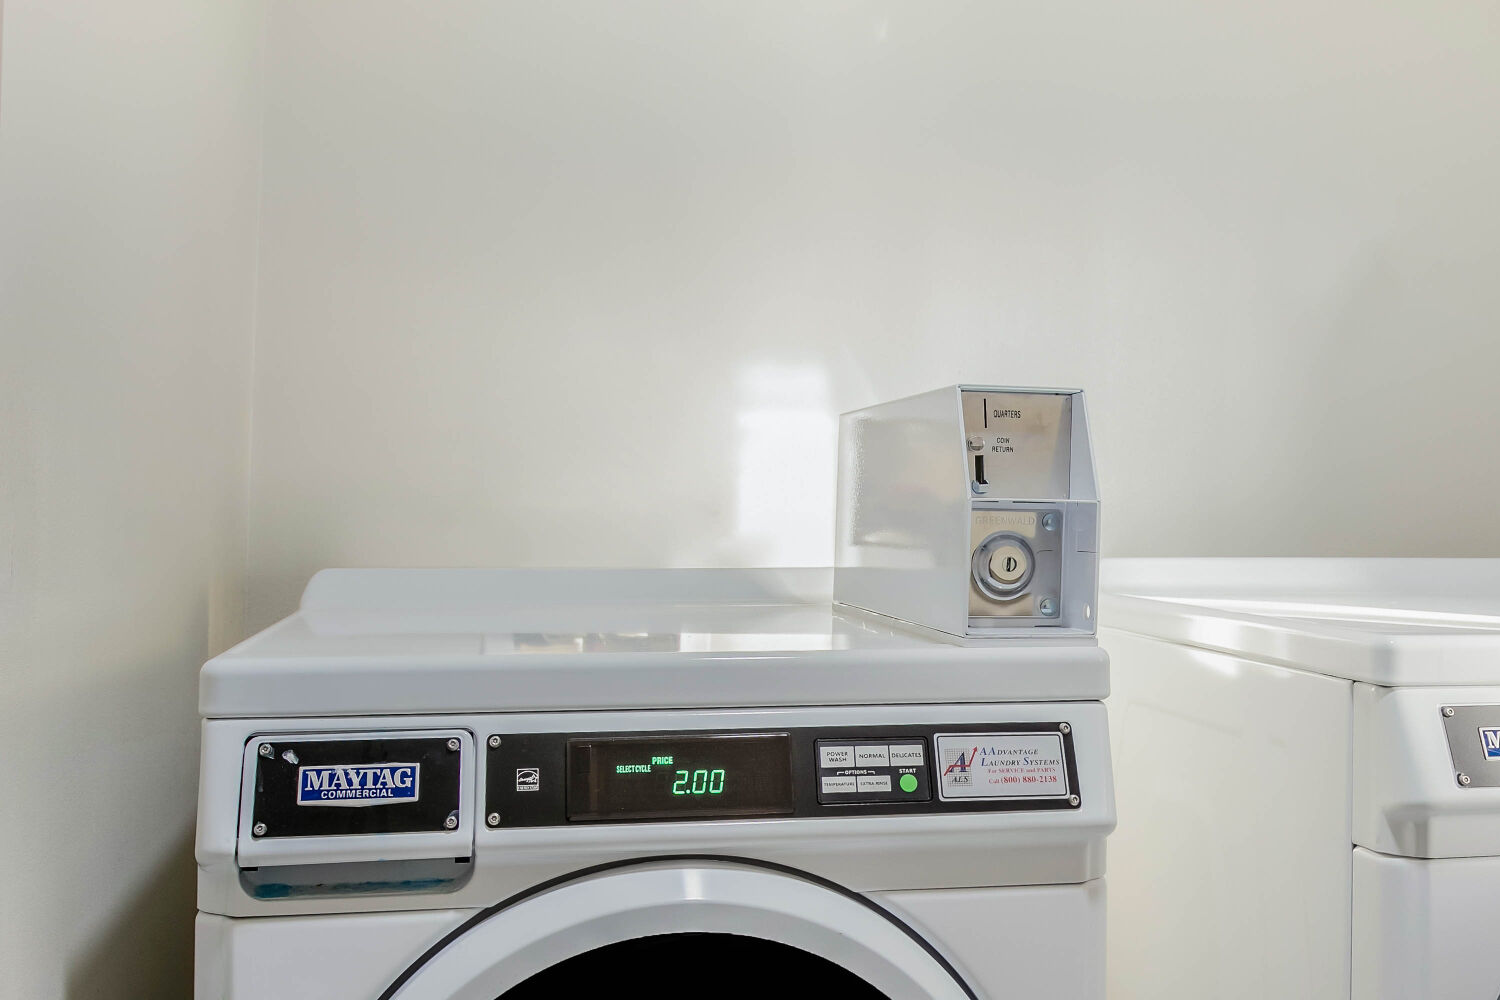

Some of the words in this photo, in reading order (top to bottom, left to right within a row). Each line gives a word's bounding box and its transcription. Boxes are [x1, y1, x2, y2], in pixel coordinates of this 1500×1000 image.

[994, 410, 1021, 419] QUARTERS
[975, 515, 1035, 526] GREENWALD
[652, 756, 673, 765] PRICE
[981, 757, 1021, 767] LAUNDRY
[1023, 756, 1060, 766] SYSTEMS
[304, 768, 413, 791] MAYTAG
[672, 769, 725, 795] 2.00
[1001, 775, 1021, 784] (800)
[1022, 774, 1057, 783] 880-2138
[321, 789, 394, 799] COMMERCIAL
